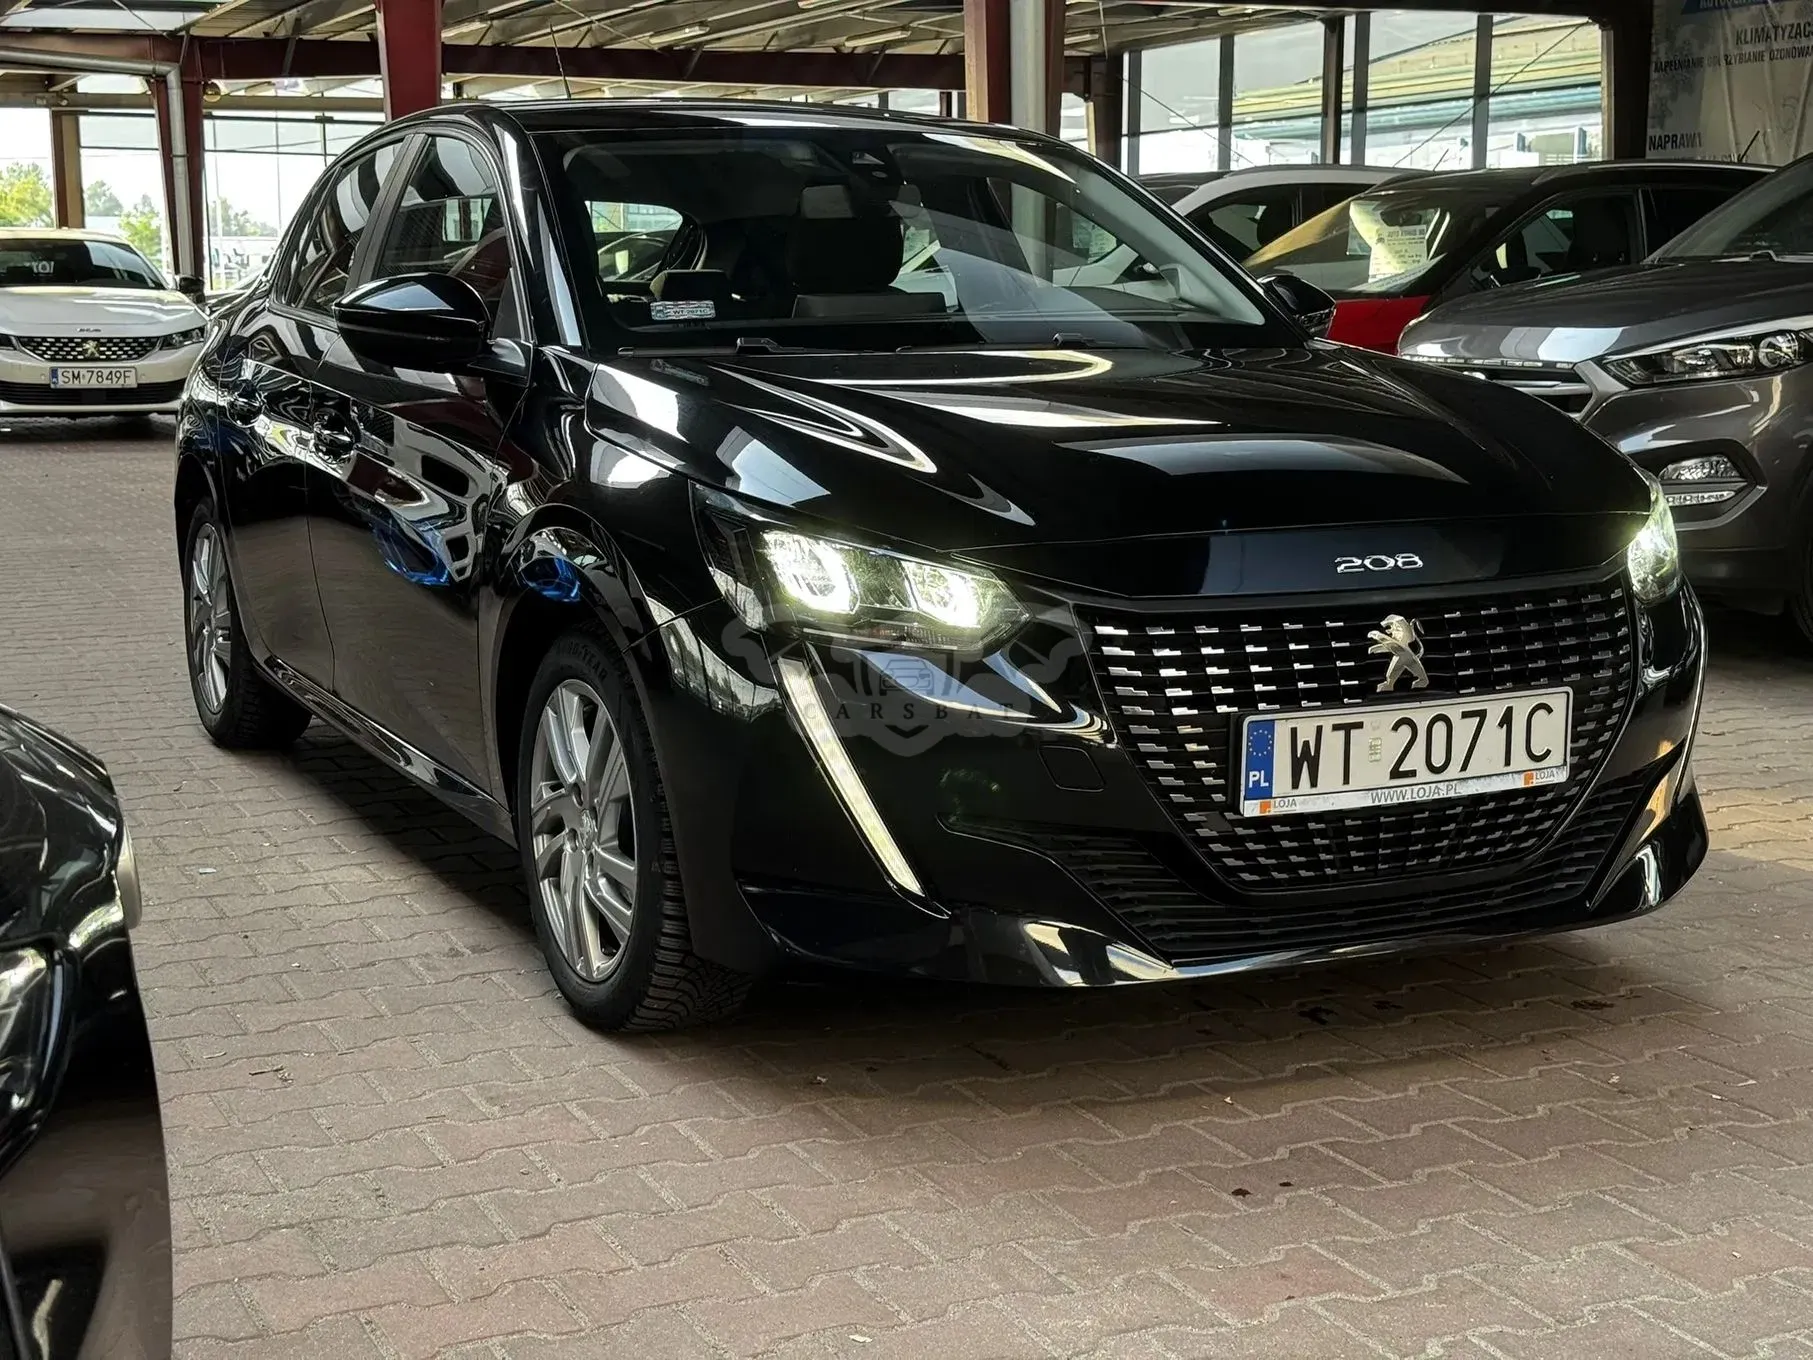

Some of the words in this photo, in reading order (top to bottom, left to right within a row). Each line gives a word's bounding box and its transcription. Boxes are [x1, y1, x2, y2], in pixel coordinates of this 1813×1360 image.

[1769, 44, 1813, 62] OZONOWA
[61, 370, 81, 384] SM
[86, 370, 132, 384] 7849F
[1334, 553, 1423, 573] 208
[1290, 721, 1364, 789] WT
[1389, 702, 1554, 780] 2071C
[1248, 770, 1269, 788] PL
[1535, 768, 1555, 780] LOJA
[1370, 783, 1461, 804] WWW.LOJA.PL
[1273, 797, 1297, 809] LOJA
